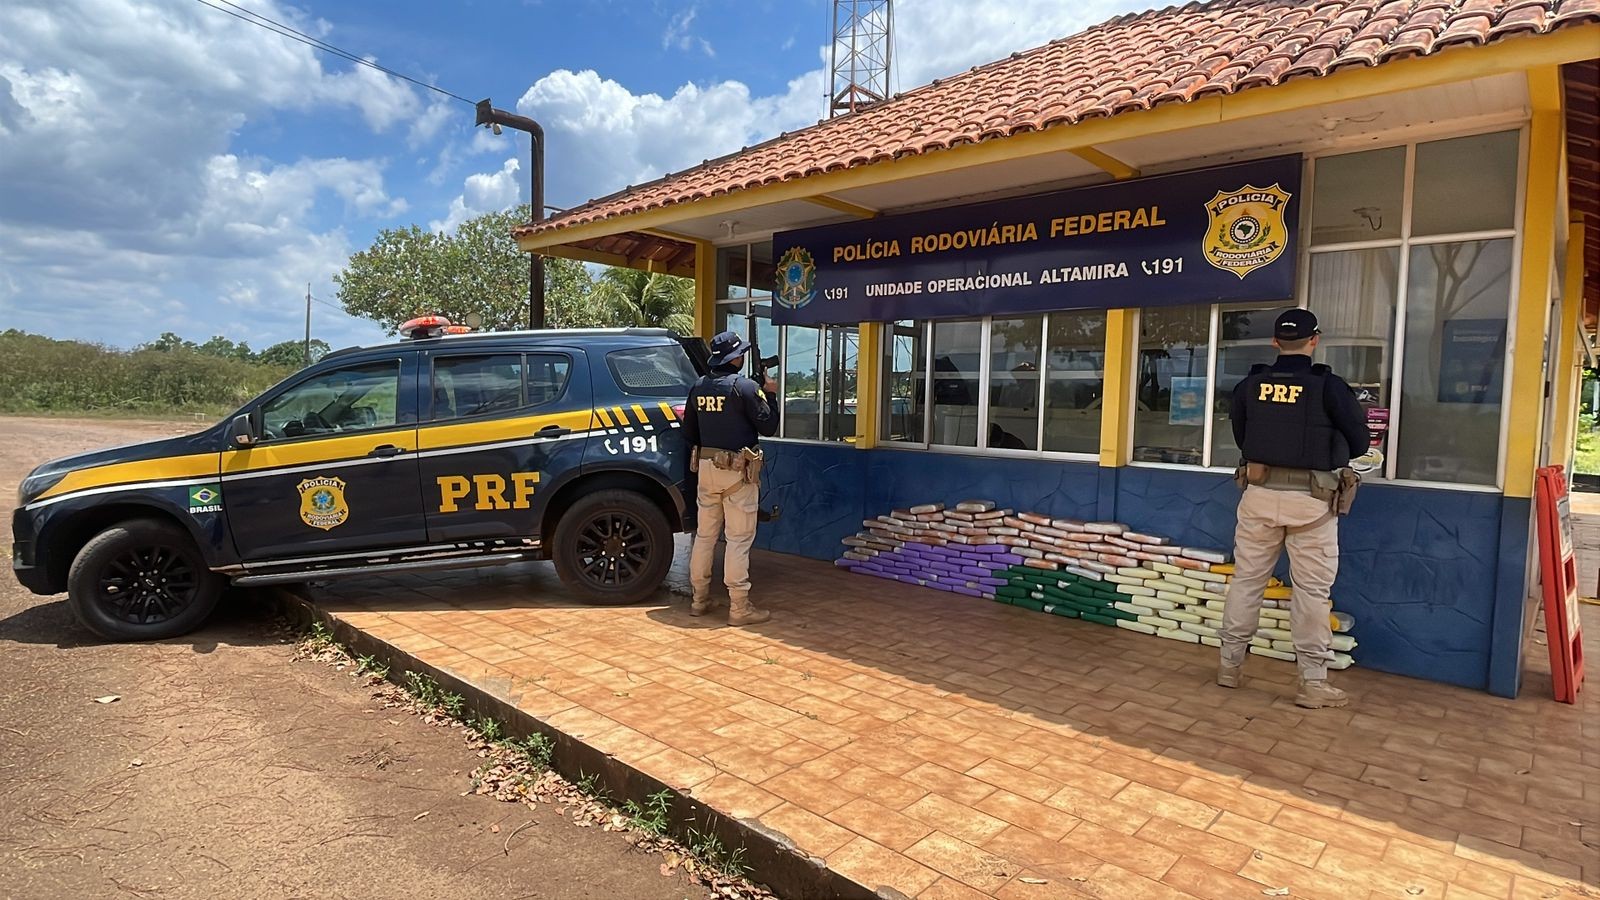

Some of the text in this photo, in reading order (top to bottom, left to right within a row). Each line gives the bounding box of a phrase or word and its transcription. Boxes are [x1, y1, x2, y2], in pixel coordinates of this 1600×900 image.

[833, 206, 1166, 263] POLÍCIA RODOVIÁRIA FEDERAL
[1222, 257, 1264, 267] FEDERAL
[831, 257, 1183, 300] 191 UNIDADE OPERACIONAL ALTAMIRA 191
[1258, 383, 1303, 403] PRF
[696, 396, 726, 412] PRF
[619, 435, 658, 454] 191
[436, 471, 540, 513] PRF
[190, 504, 223, 514] BRASIL
